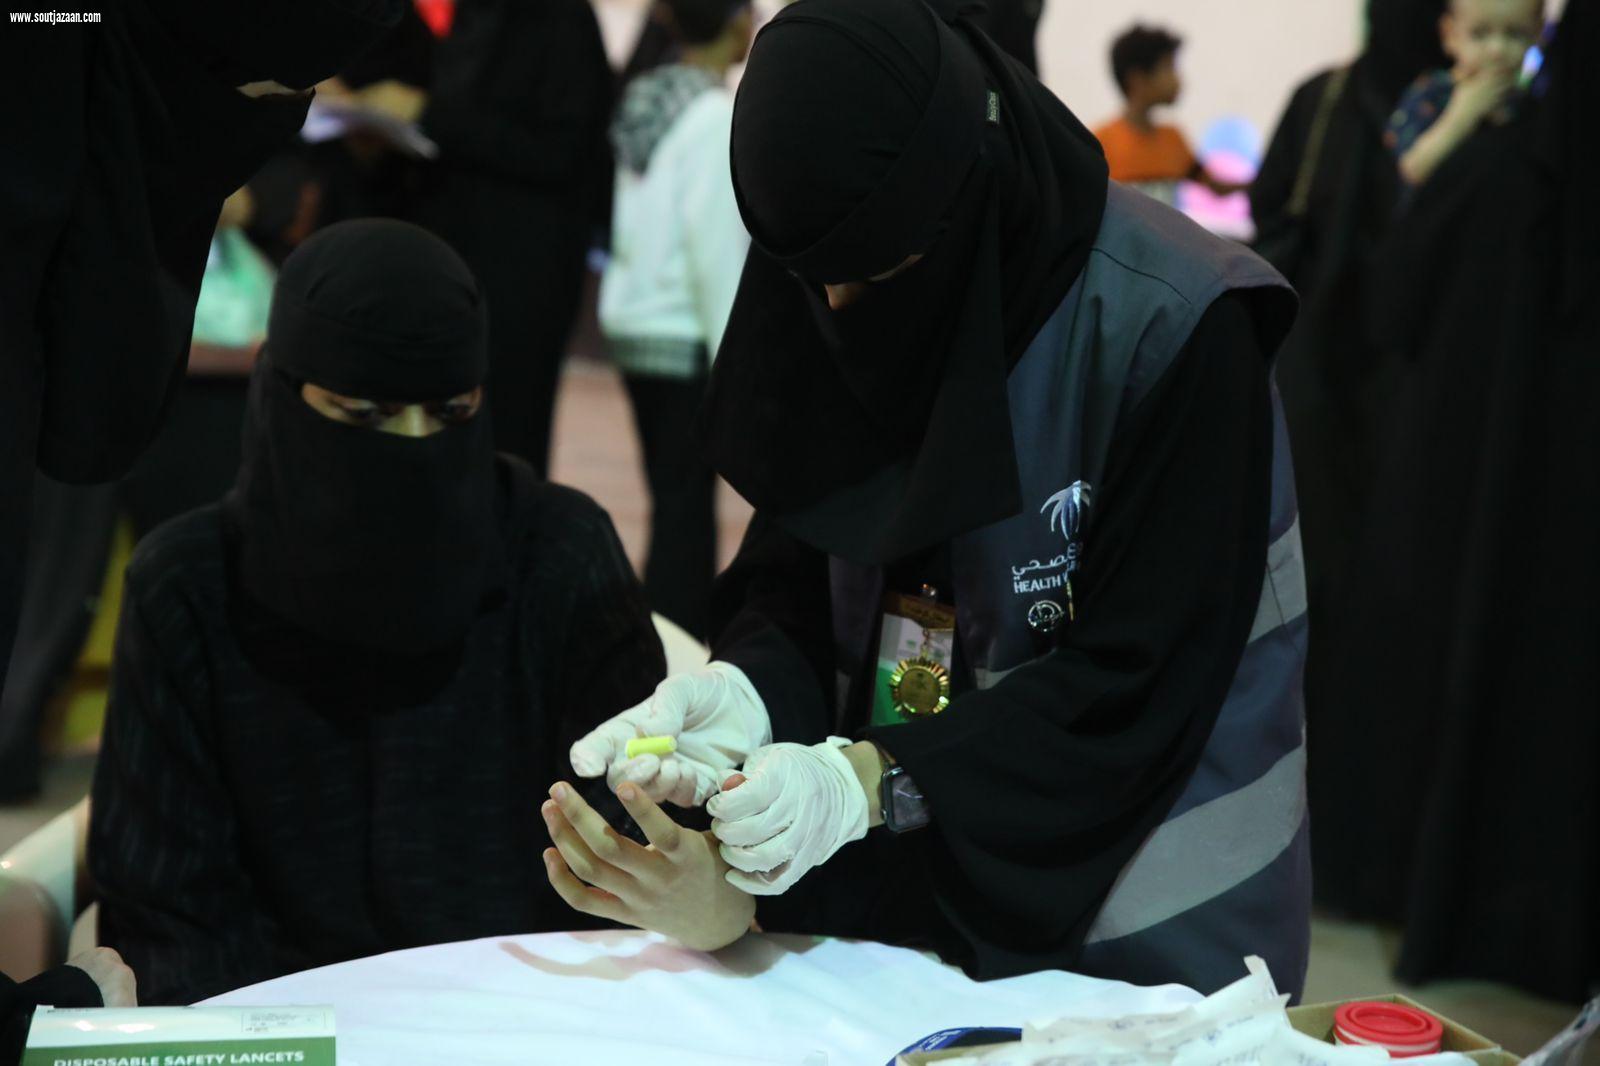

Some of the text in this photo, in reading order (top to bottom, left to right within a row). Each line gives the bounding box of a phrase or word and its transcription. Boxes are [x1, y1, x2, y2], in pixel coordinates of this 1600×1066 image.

[1013, 574, 1061, 594] HEALTH
[54, 1050, 304, 1066] DISPOSABLE SAFETY LANCETS
